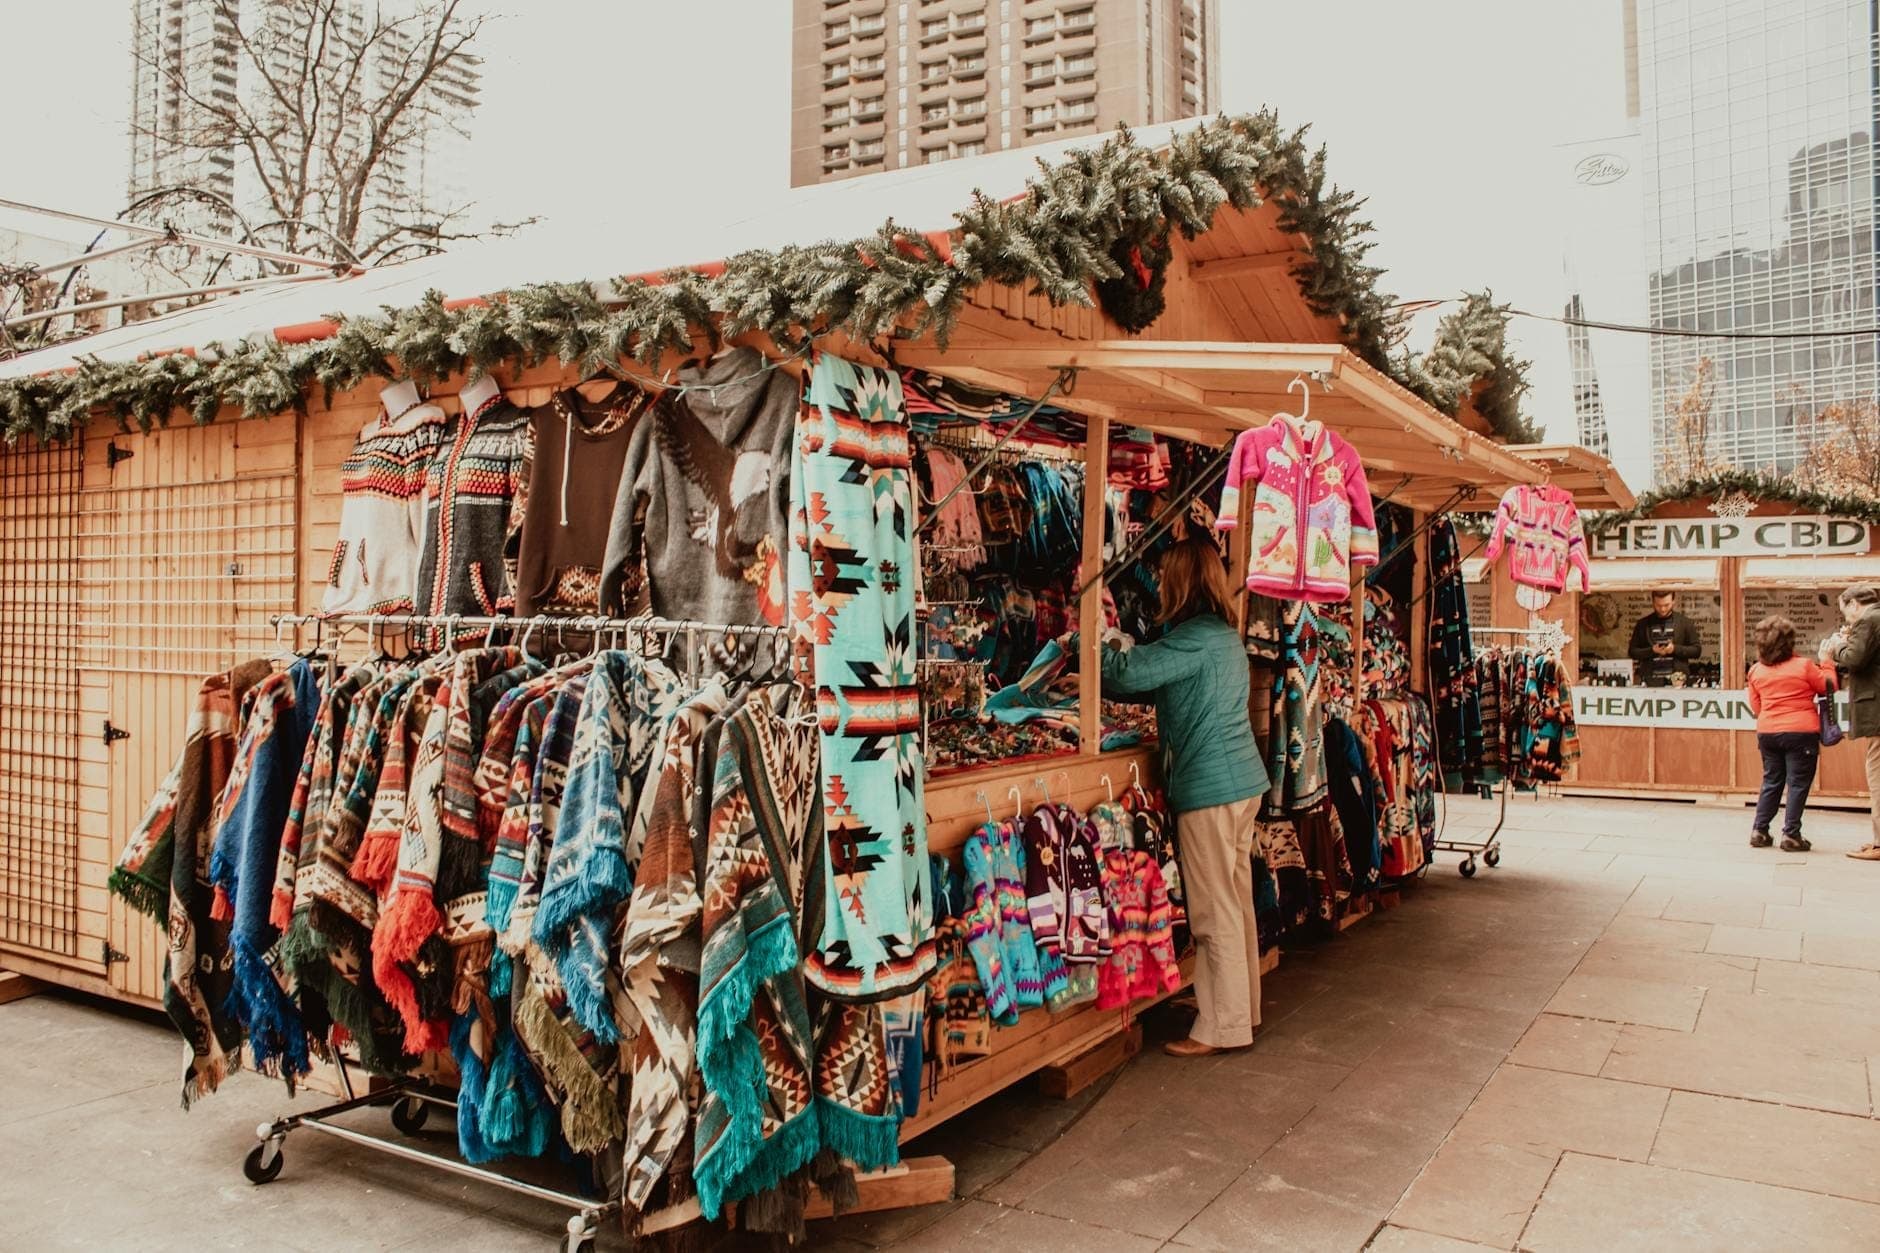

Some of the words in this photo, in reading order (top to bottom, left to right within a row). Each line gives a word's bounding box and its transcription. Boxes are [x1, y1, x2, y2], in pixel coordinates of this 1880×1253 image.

[1597, 523, 1740, 551] HEMP
[1754, 520, 1866, 548] CBD
[1580, 697, 1676, 718] HEMP
[1682, 699, 1757, 719] PAIN
